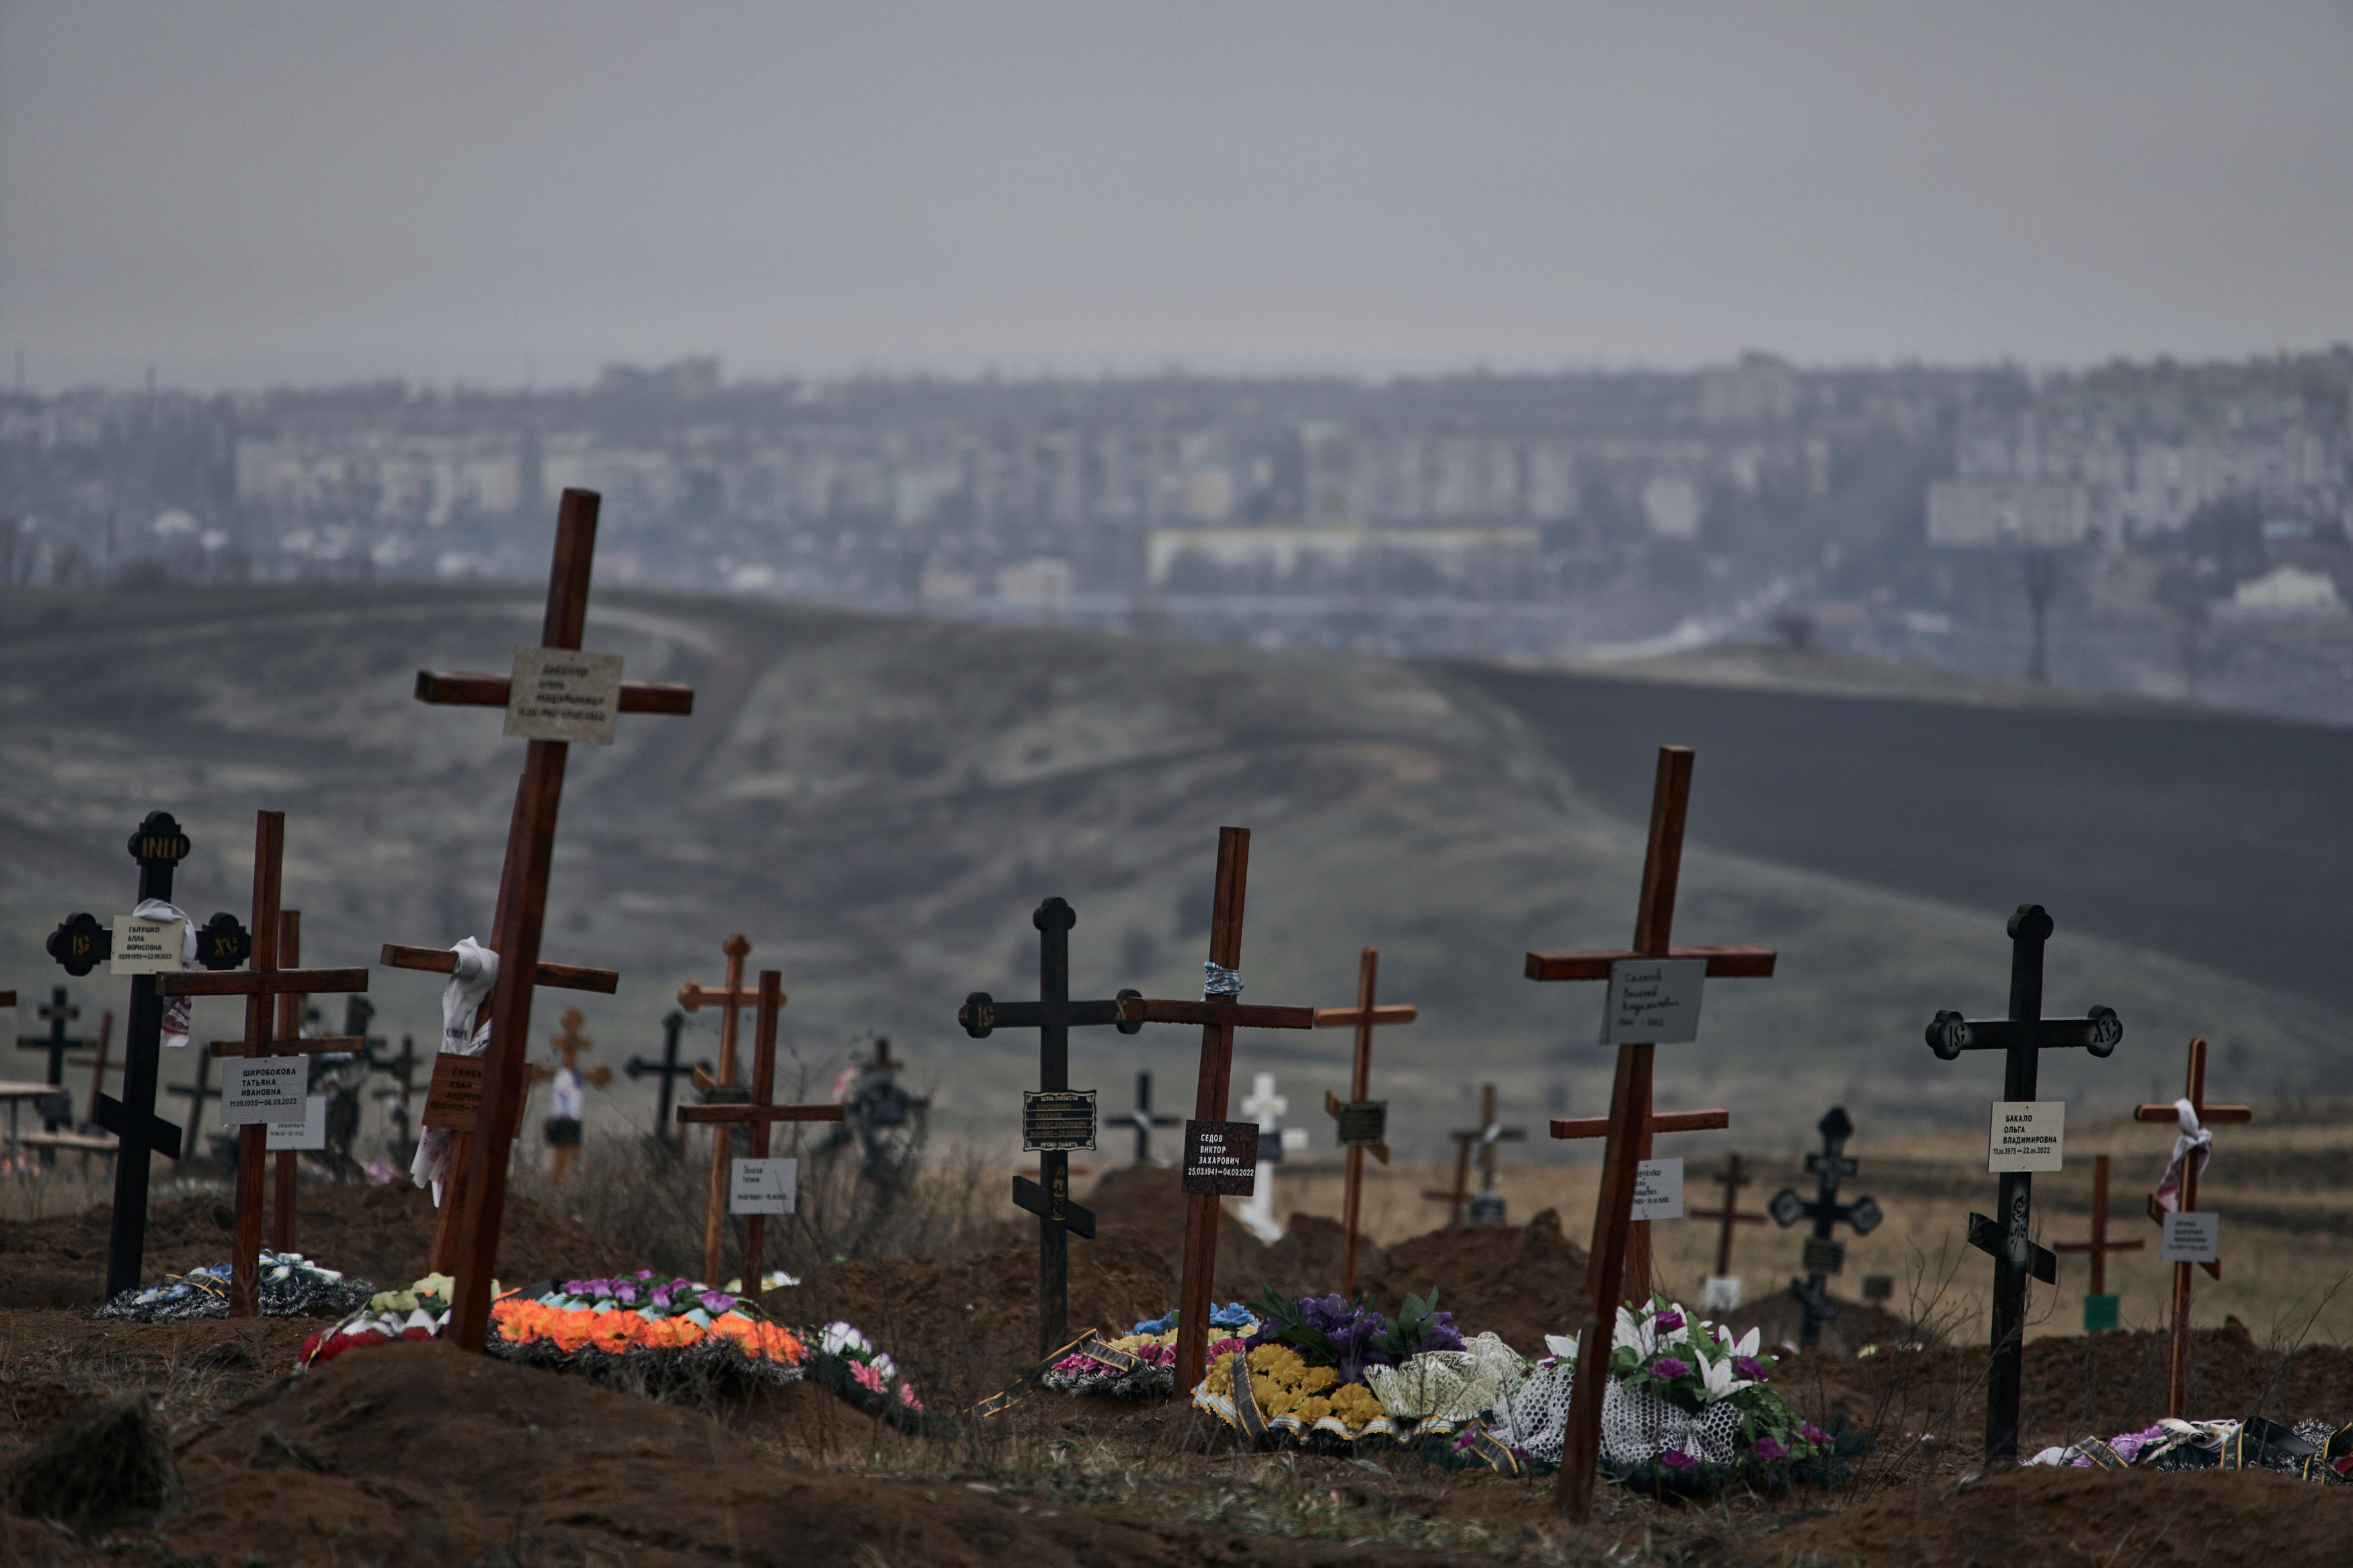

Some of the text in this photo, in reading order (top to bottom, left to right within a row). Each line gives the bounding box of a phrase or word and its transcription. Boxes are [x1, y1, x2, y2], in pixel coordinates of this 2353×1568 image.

[243, 1068, 296, 1077] ШИРОБОКОВА
[452, 1068, 482, 1078] СКИБА
[242, 1079, 276, 1087] ТАТЬЯНА
[449, 1081, 472, 1089] ИВАН
[1201, 1134, 1223, 1143] СЕДОВ
[2003, 1137, 2057, 1145] ВЛАДИМИРОВНА
[1199, 1157, 1240, 1165] ЗАХАРОВИЧ
